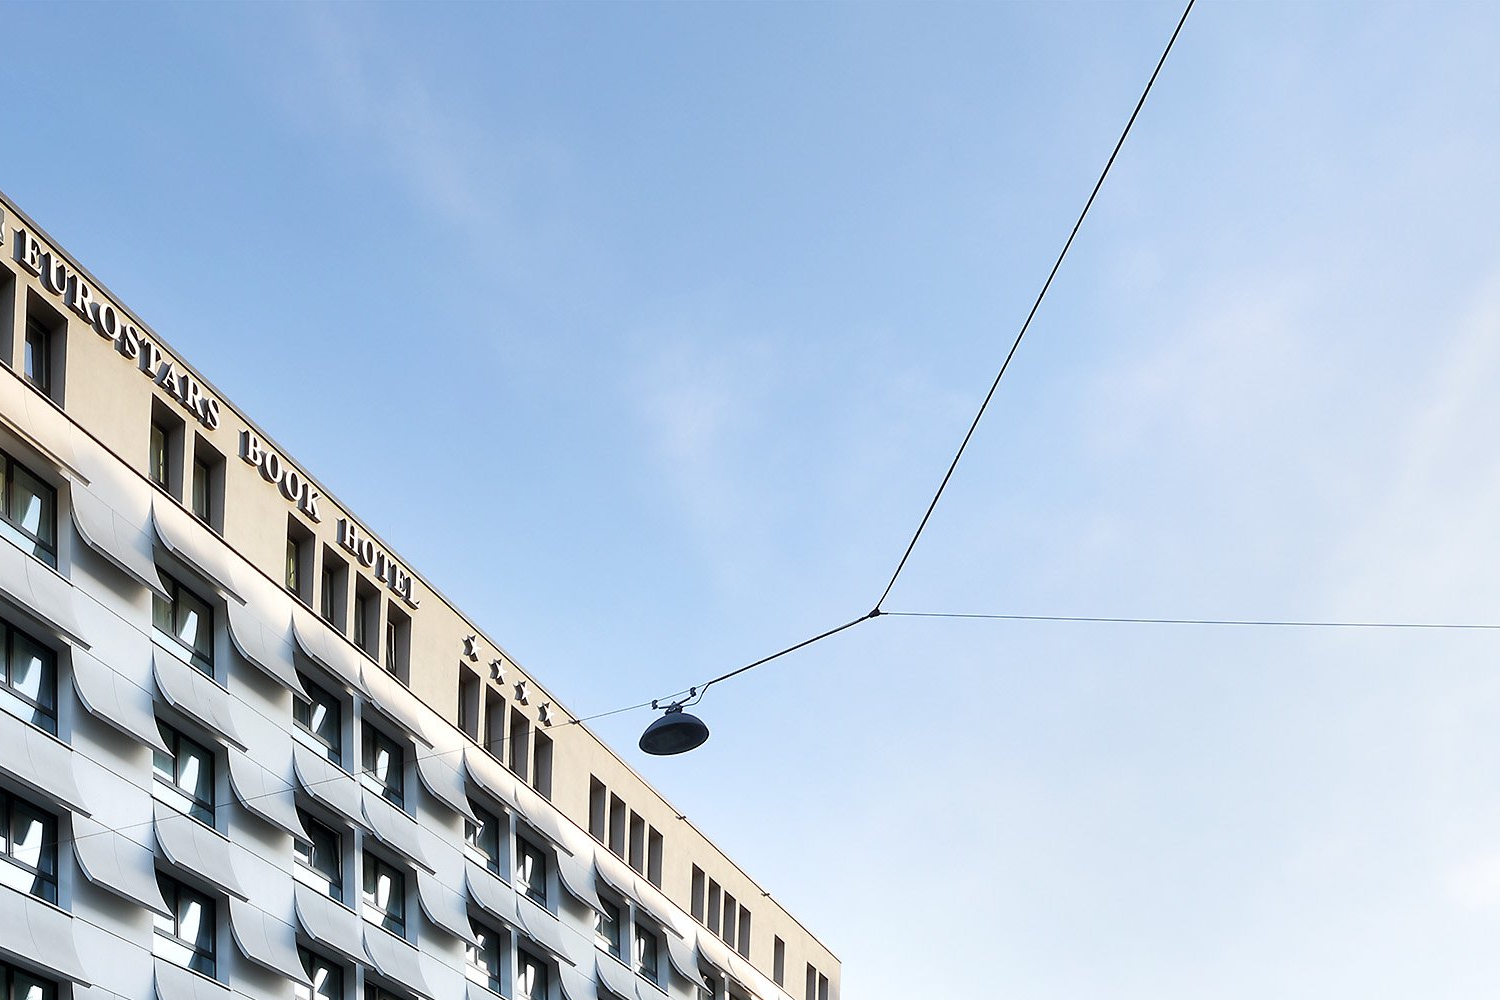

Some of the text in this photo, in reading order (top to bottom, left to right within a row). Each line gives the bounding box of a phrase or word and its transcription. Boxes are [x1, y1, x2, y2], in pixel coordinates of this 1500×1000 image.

[18, 228, 421, 610] EUROSTARS BOOK HOTEL
